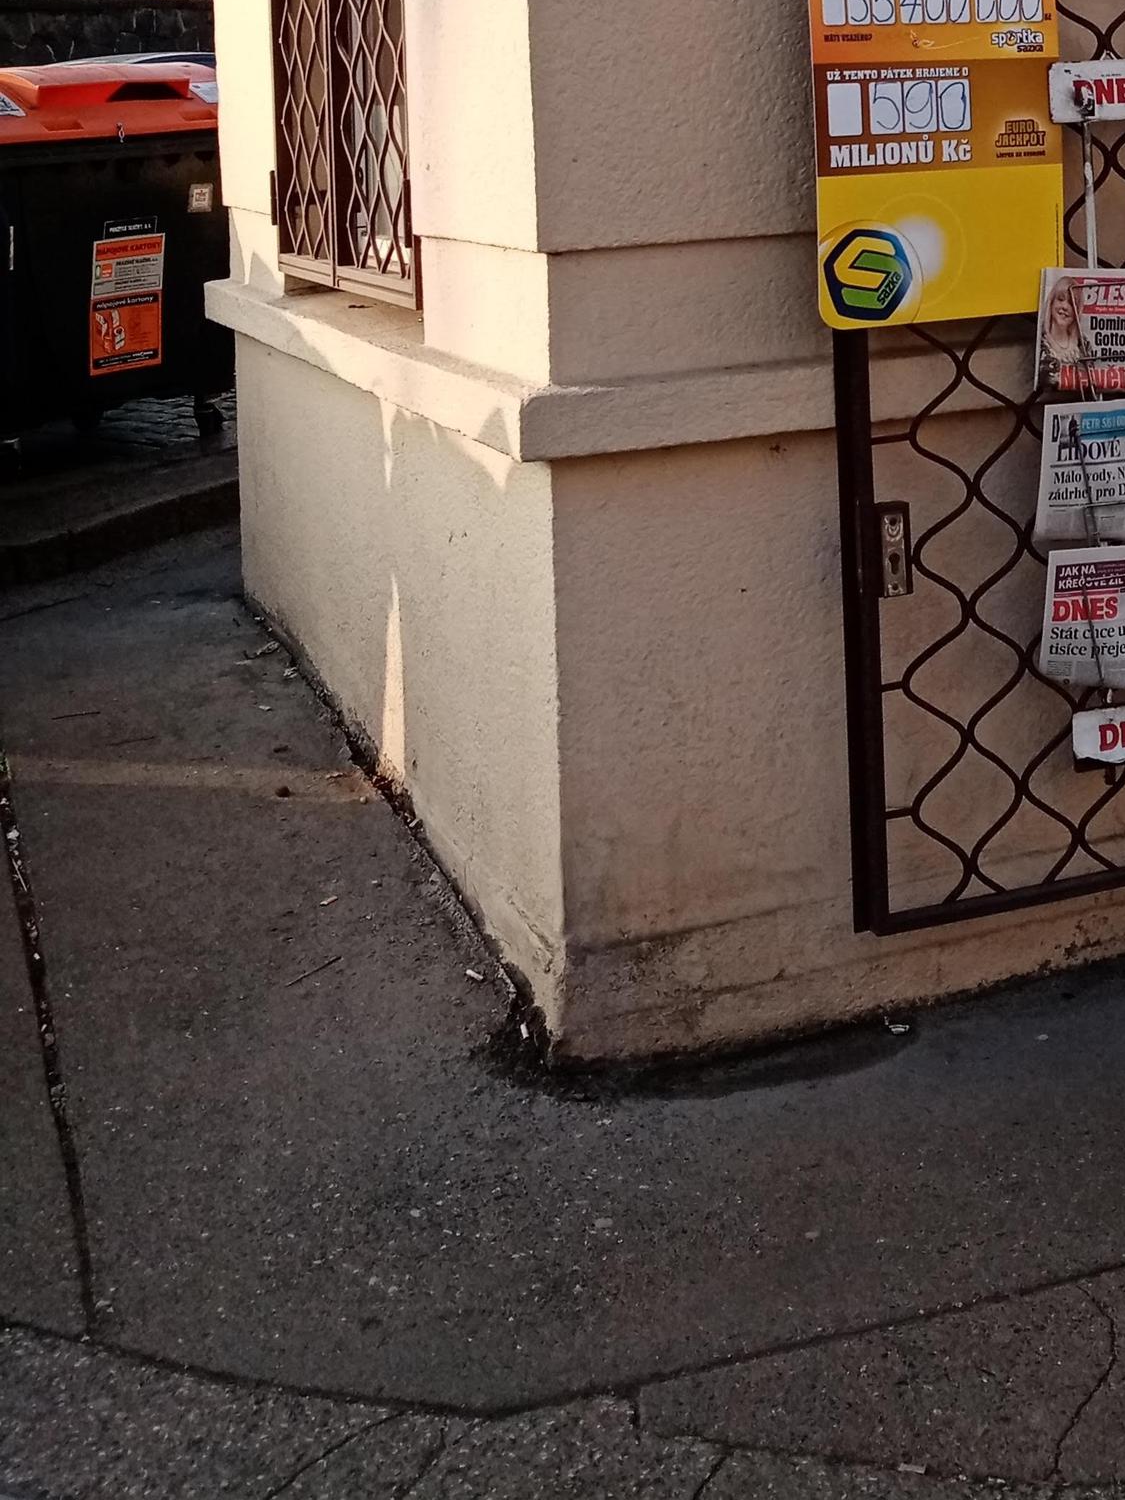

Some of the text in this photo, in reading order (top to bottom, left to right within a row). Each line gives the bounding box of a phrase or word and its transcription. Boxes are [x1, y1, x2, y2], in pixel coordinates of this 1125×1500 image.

[991, 29, 1044, 47] sportka
[826, 67, 969, 81] UŽ TENTO PÁTEK HRAJEME O
[873, 80, 967, 130] 590
[1005, 119, 1034, 133] EURO
[995, 131, 1046, 147] JACKPOT
[830, 134, 972, 168] MILIONŮ Kč
[1054, 471, 1081, 485] Málo
[1085, 470, 1115, 484] vody.
[1048, 486, 1092, 501] zádrhel
[1096, 488, 1115, 501] pro
[1060, 566, 1078, 577] JAK
[1081, 565, 1096, 576] NA
[1052, 596, 1118, 622] DNES
[1050, 625, 1079, 640] Stát
[1083, 625, 1115, 639] chce
[1049, 642, 1087, 656] tisíce
